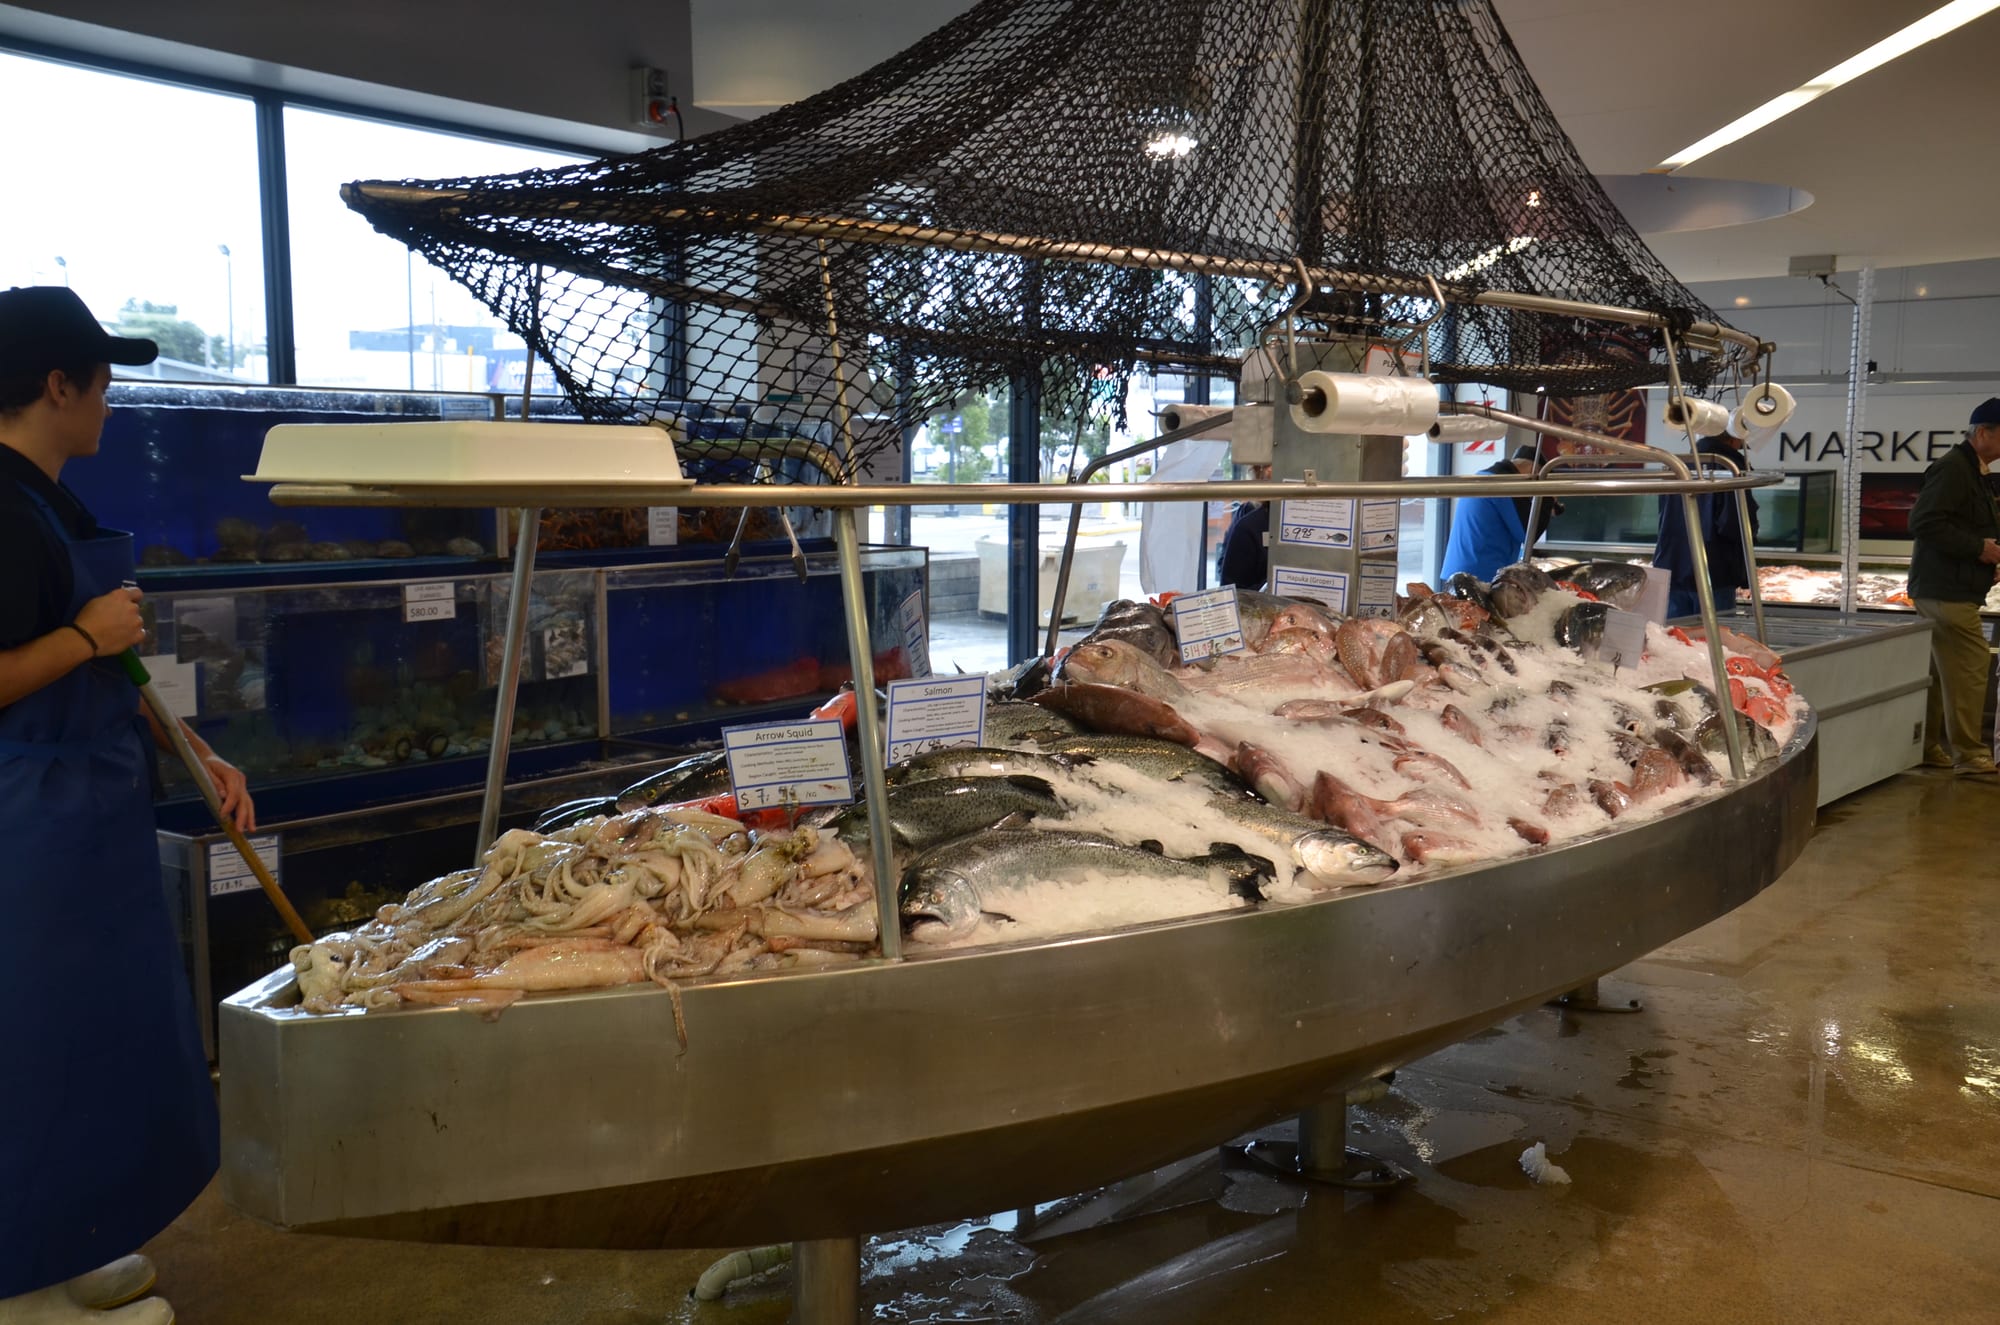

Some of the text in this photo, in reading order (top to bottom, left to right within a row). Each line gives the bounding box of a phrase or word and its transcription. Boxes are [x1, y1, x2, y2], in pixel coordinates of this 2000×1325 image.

[1779, 430, 1967, 462] MARKE
[1286, 574, 1335, 586] Hapuka (Groper)
[410, 607, 439, 618] $80.00
[923, 686, 953, 697] Salmon
[755, 728, 814, 742] Arrow Squid
